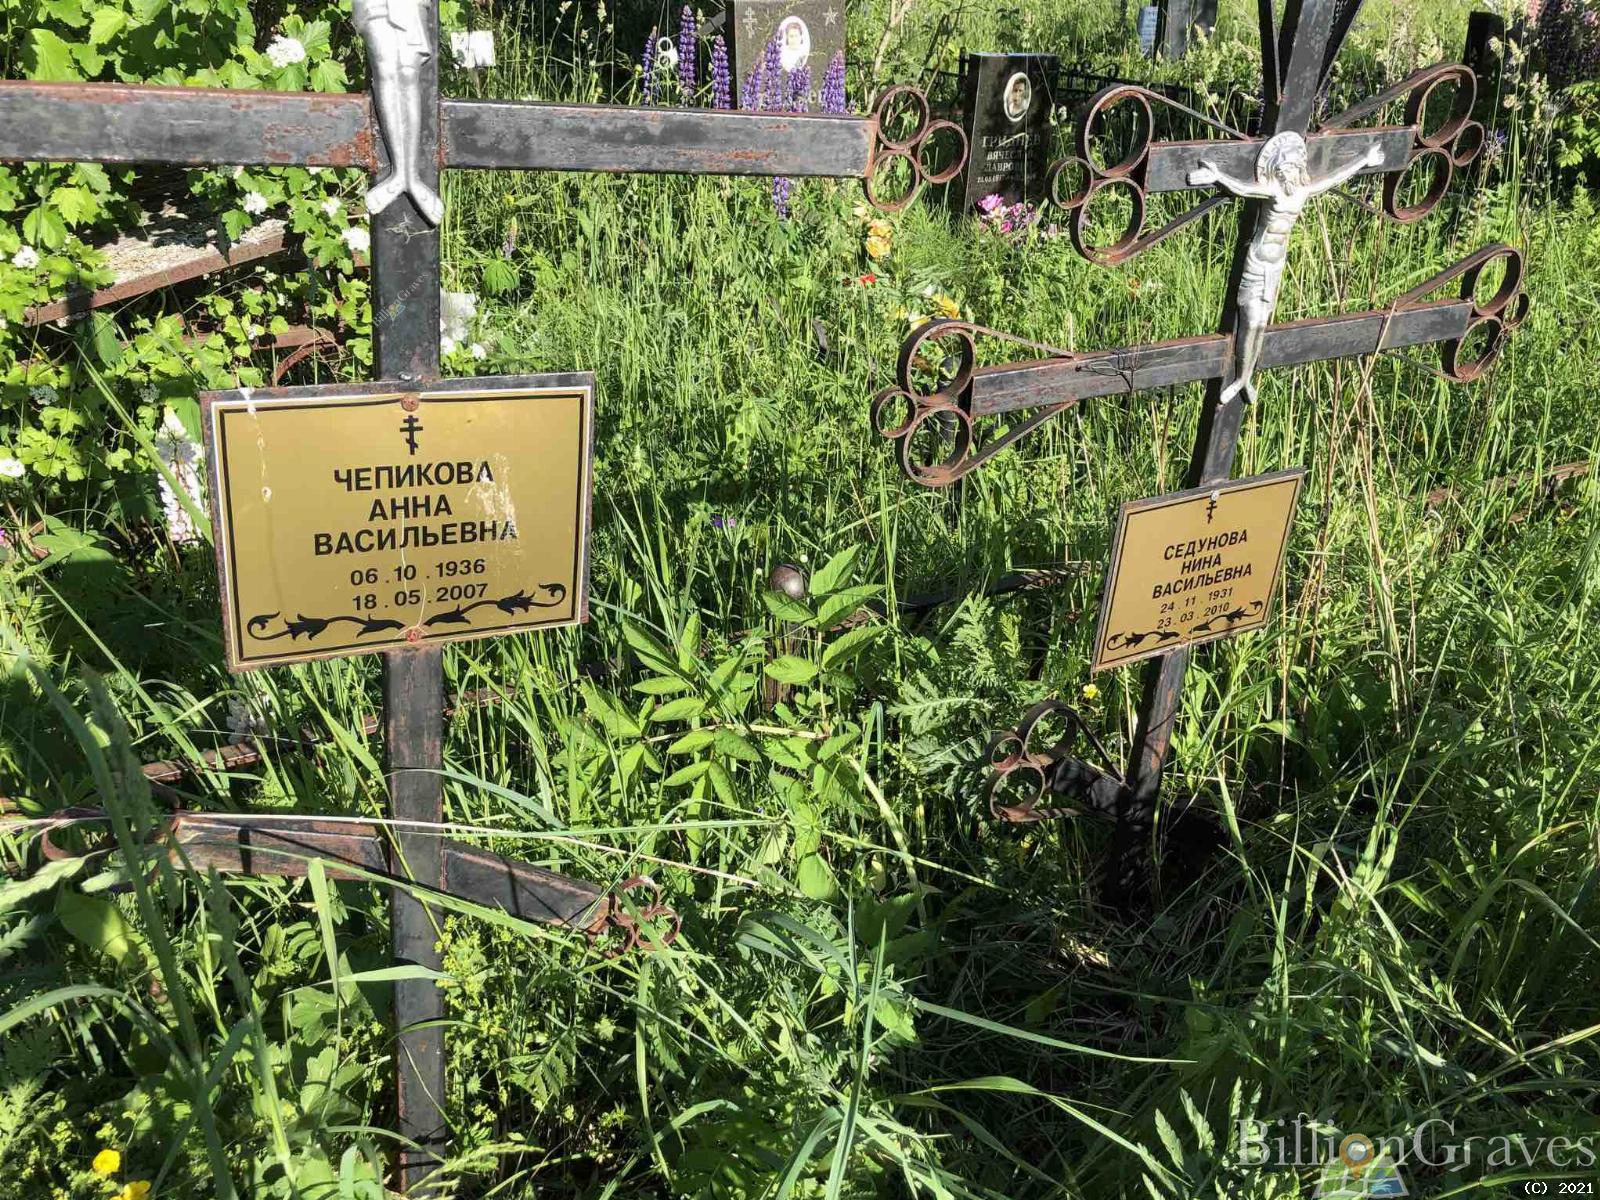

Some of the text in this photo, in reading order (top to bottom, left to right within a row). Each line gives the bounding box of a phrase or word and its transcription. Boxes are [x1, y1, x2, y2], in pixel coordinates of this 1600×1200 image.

[334, 461, 494, 492] ЧЕПИКОВА
[368, 494, 452, 521] АННА
[314, 520, 518, 555] ВАСИЛЬЕВНА
[1164, 529, 1247, 560] СЕДУНОВА
[1181, 553, 1221, 575] НИНА
[1152, 563, 1252, 599] ВАСИЛЬЕВНА
